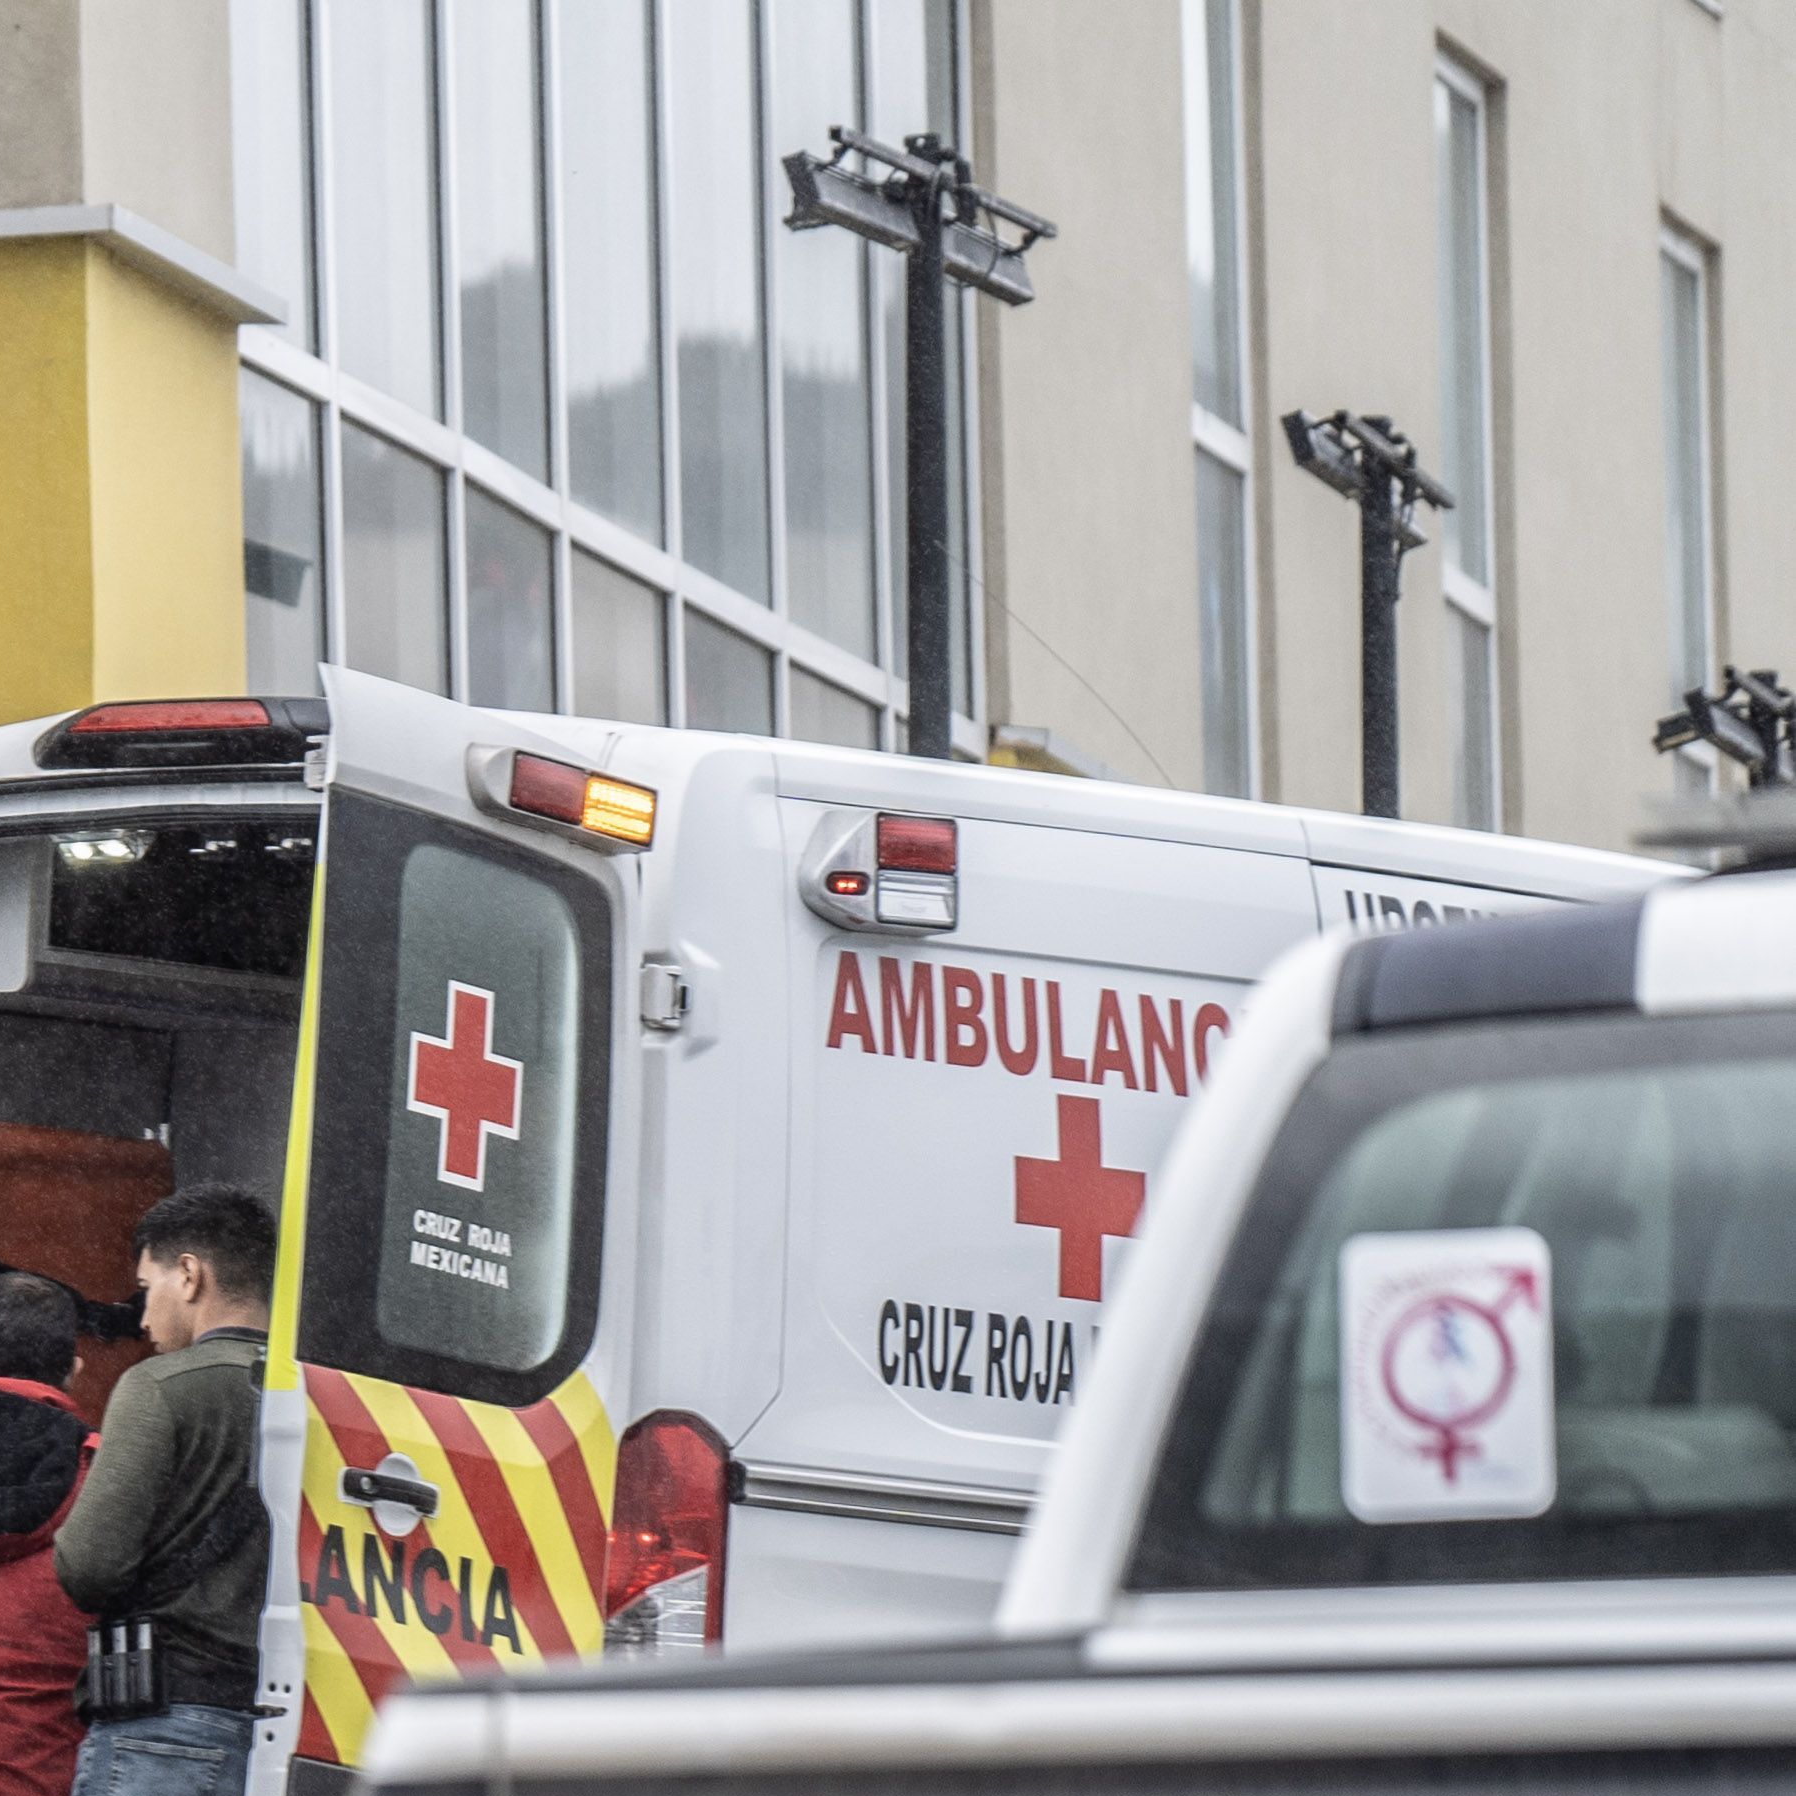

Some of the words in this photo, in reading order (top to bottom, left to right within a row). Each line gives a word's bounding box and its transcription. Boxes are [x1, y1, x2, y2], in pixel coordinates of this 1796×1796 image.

[410, 1240, 510, 1290] MEXICANA
[413, 1209, 462, 1243] CRUZ
[468, 1222, 513, 1257] ROJA
[878, 1298, 975, 1394] CRUZ
[985, 1312, 1076, 1406] ROJA
[301, 1524, 522, 1655] ANCIA
